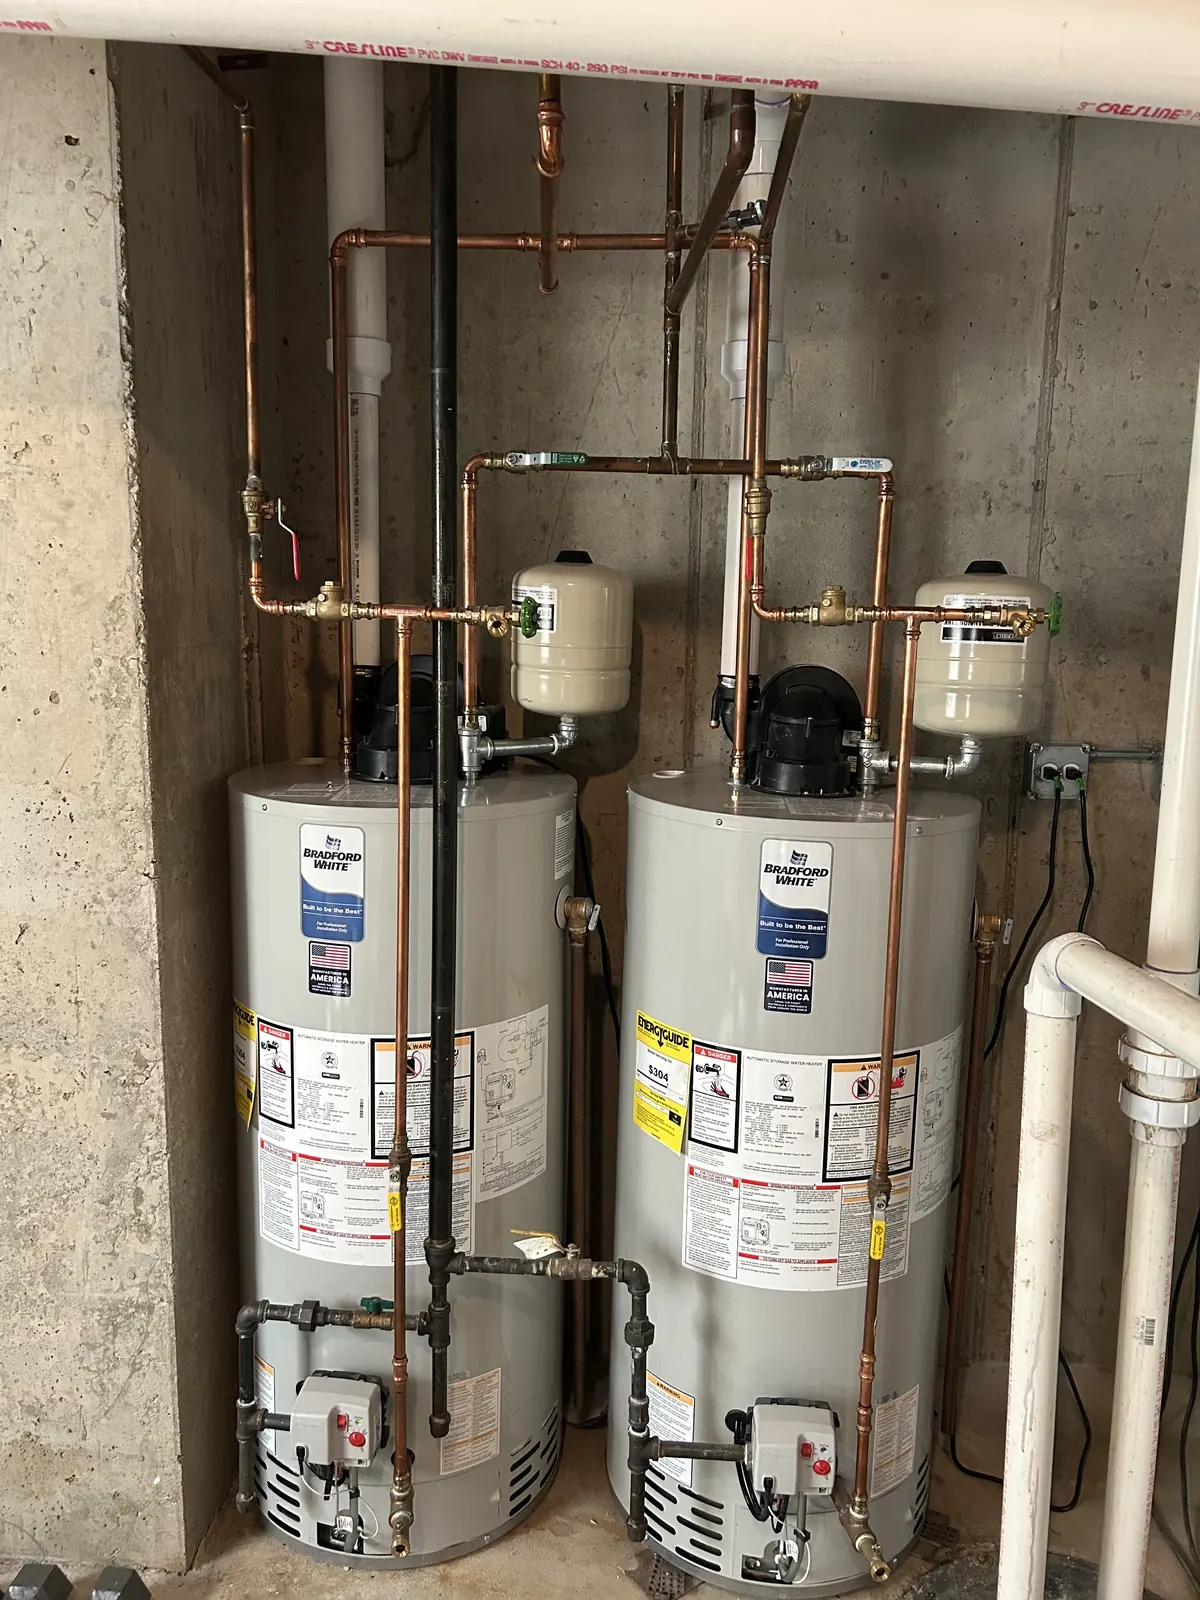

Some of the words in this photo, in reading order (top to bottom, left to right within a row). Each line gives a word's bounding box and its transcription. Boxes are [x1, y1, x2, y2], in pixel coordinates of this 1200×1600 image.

[418, 49, 440, 60] PVC
[442, 51, 465, 62] DWV
[541, 59, 563, 69] SCH
[565, 61, 580, 71] 40
[587, 63, 608, 73] 260
[611, 65, 628, 74] PSI
[303, 848, 362, 863] BRADFORD
[313, 859, 349, 872] WHITE
[763, 864, 829, 879] BRADFORD
[775, 875, 815, 888] WHITE
[759, 920, 775, 928] Built
[310, 973, 349, 984] AMERICA
[766, 990, 810, 1001] AMERICA
[638, 1015, 690, 1049] ENERGYGUIDE
[708, 1050, 732, 1061] DANGER
[746, 1055, 770, 1063] AUTOMATIC
[660, 1382, 680, 1399] WARNING
